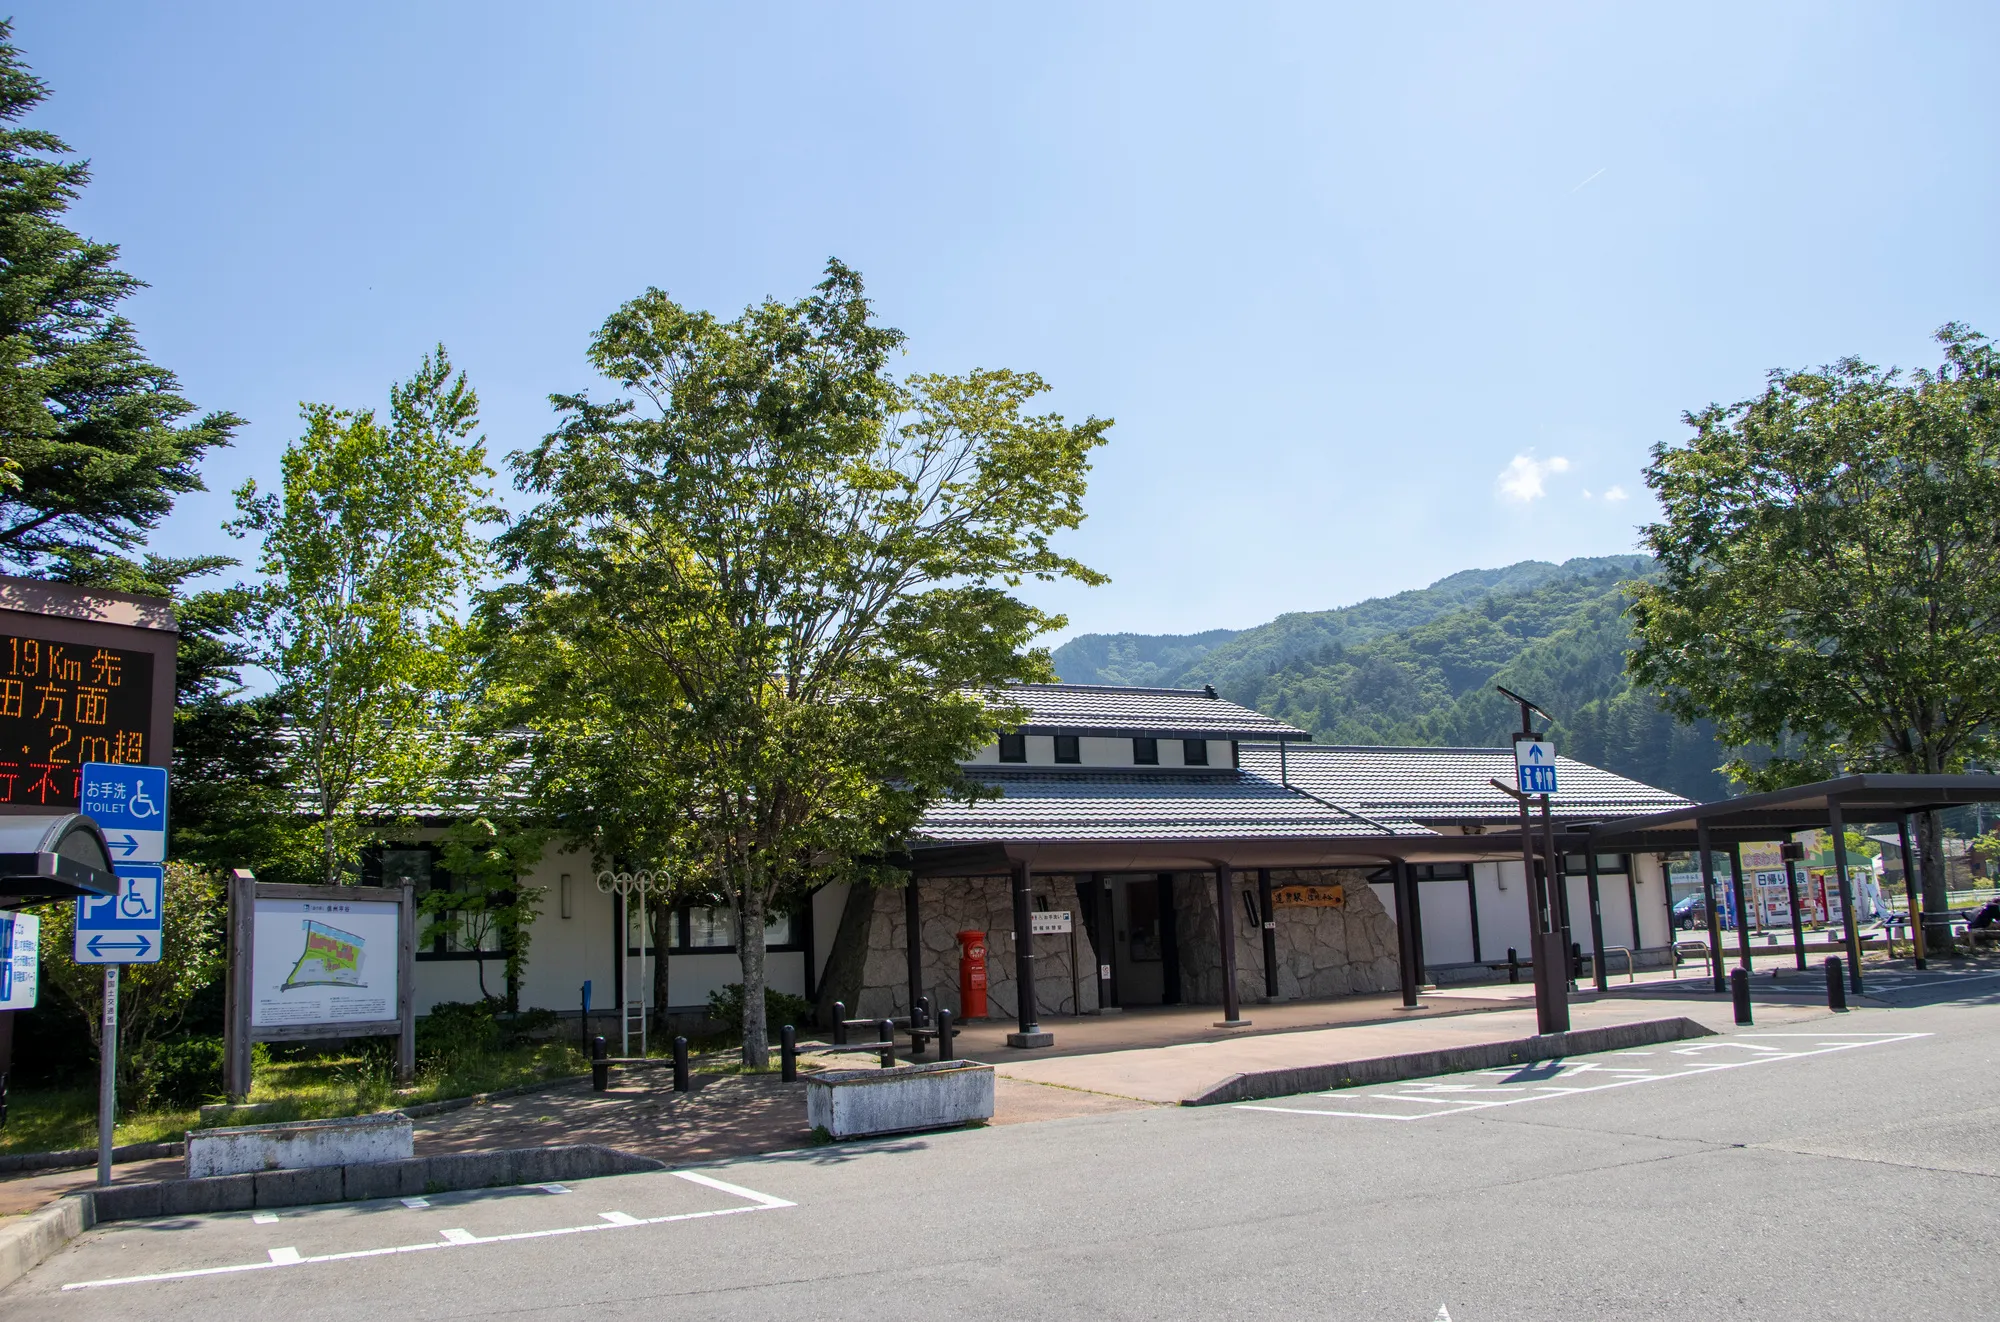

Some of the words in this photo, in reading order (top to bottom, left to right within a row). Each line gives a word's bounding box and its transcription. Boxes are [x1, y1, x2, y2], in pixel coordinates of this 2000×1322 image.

[86, 781, 126, 800] お手洗
[86, 802, 126, 813] TOILET
[1758, 873, 1807, 886] 日帰り泉
[106, 980, 115, 1024] 国土交通省
